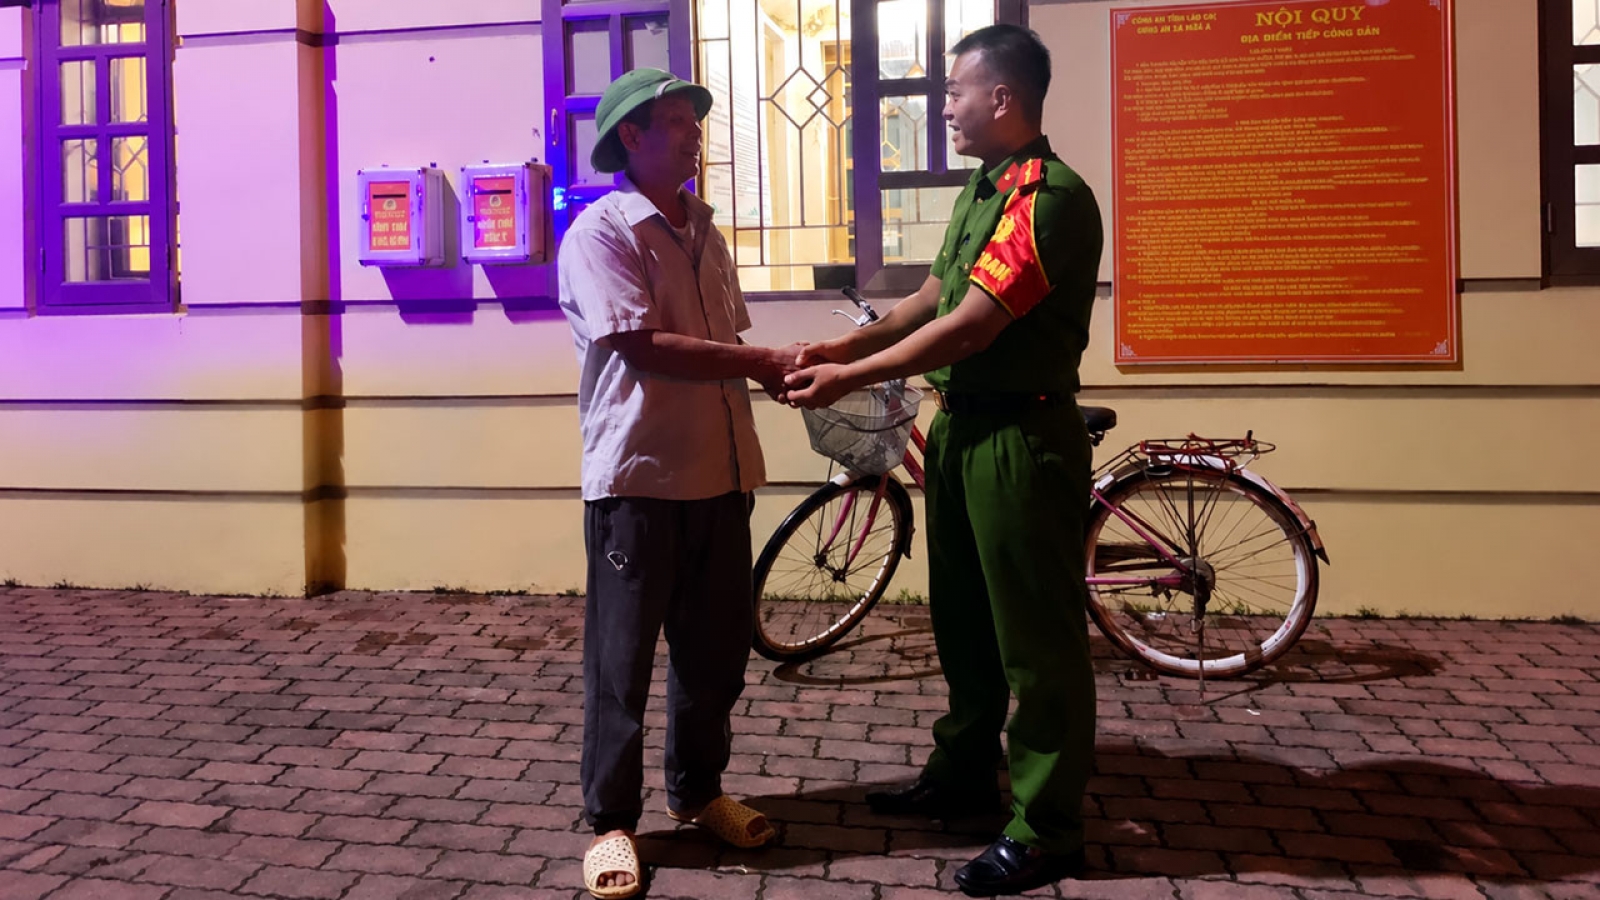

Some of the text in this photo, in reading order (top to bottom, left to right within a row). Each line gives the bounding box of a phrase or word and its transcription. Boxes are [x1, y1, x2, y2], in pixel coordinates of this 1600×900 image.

[1255, 5, 1365, 28] NỘI QUY
[1324, 28, 1353, 38] CÔNG
